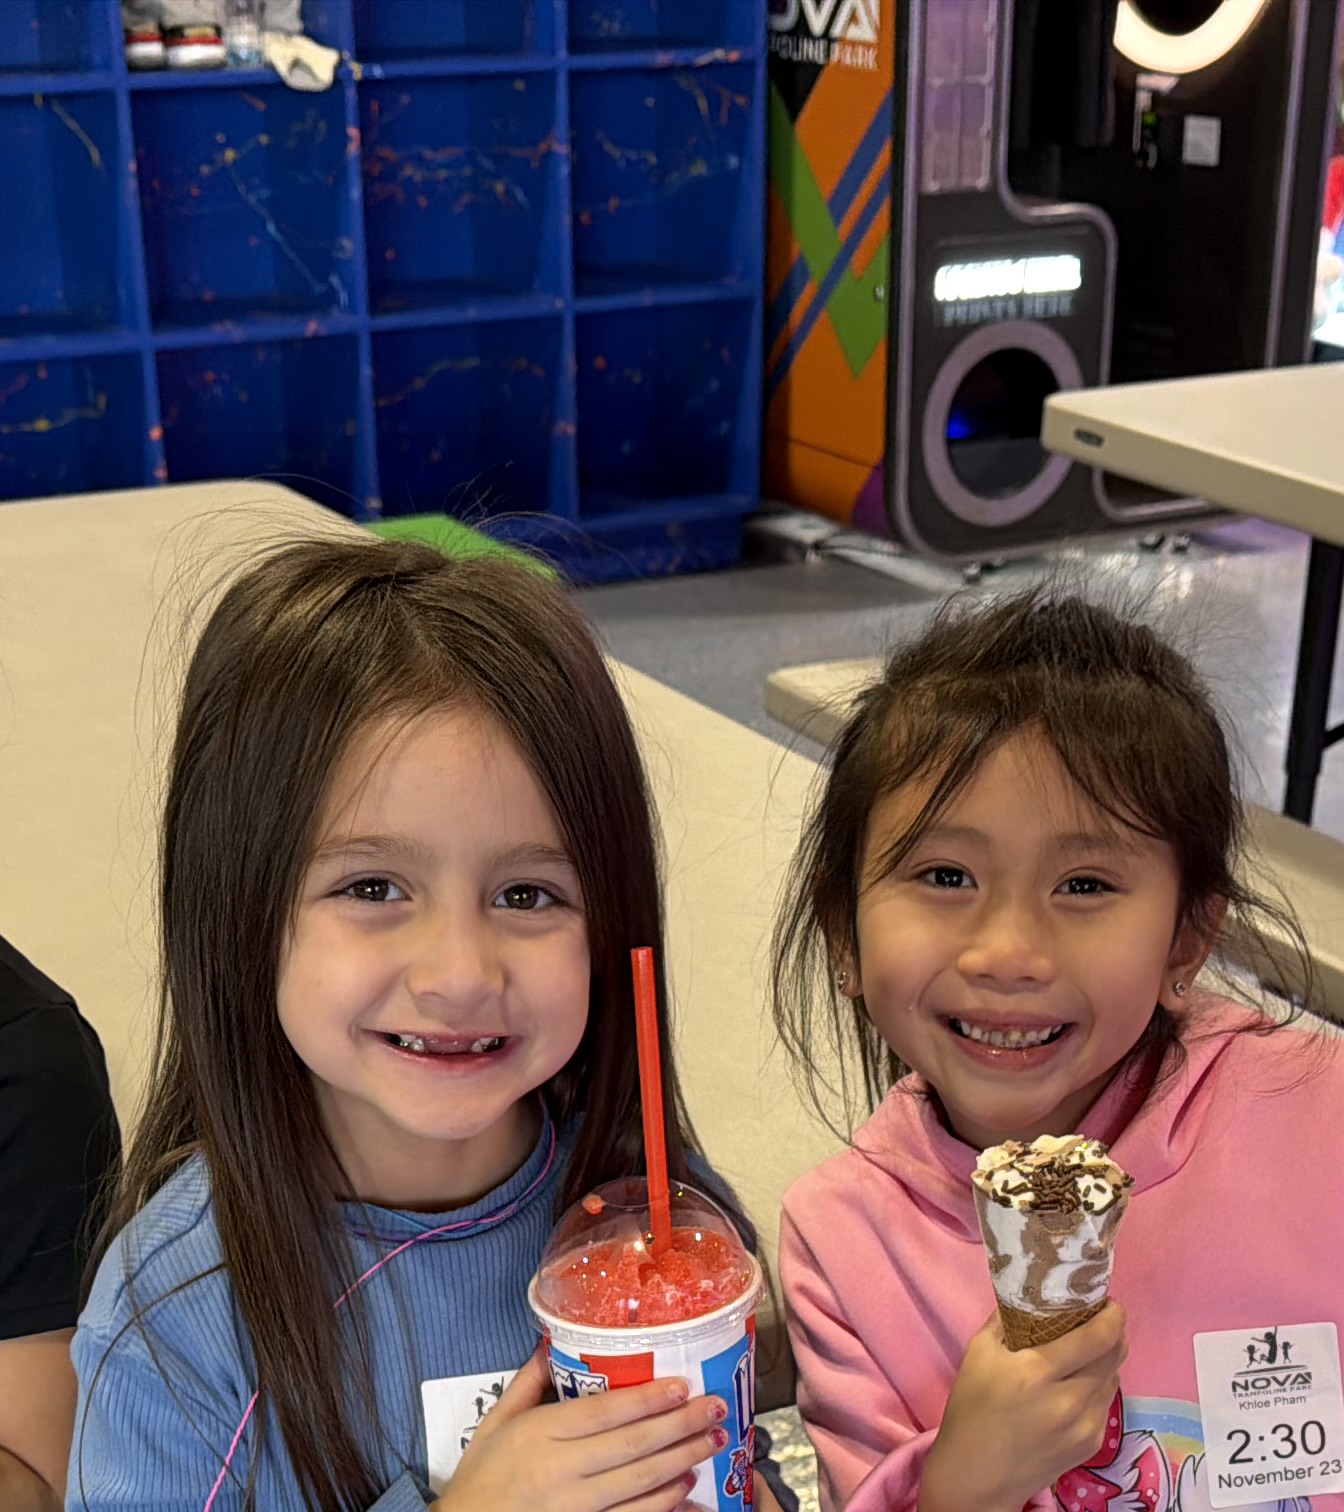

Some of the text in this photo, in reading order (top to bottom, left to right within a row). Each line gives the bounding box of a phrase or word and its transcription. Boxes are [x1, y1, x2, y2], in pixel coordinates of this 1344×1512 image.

[1231, 1371, 1312, 1393] NOVA
[1239, 1396, 1307, 1411] Khloe Pham
[1226, 1420, 1326, 1465] 2:30
[1217, 1458, 1343, 1489] November 23
